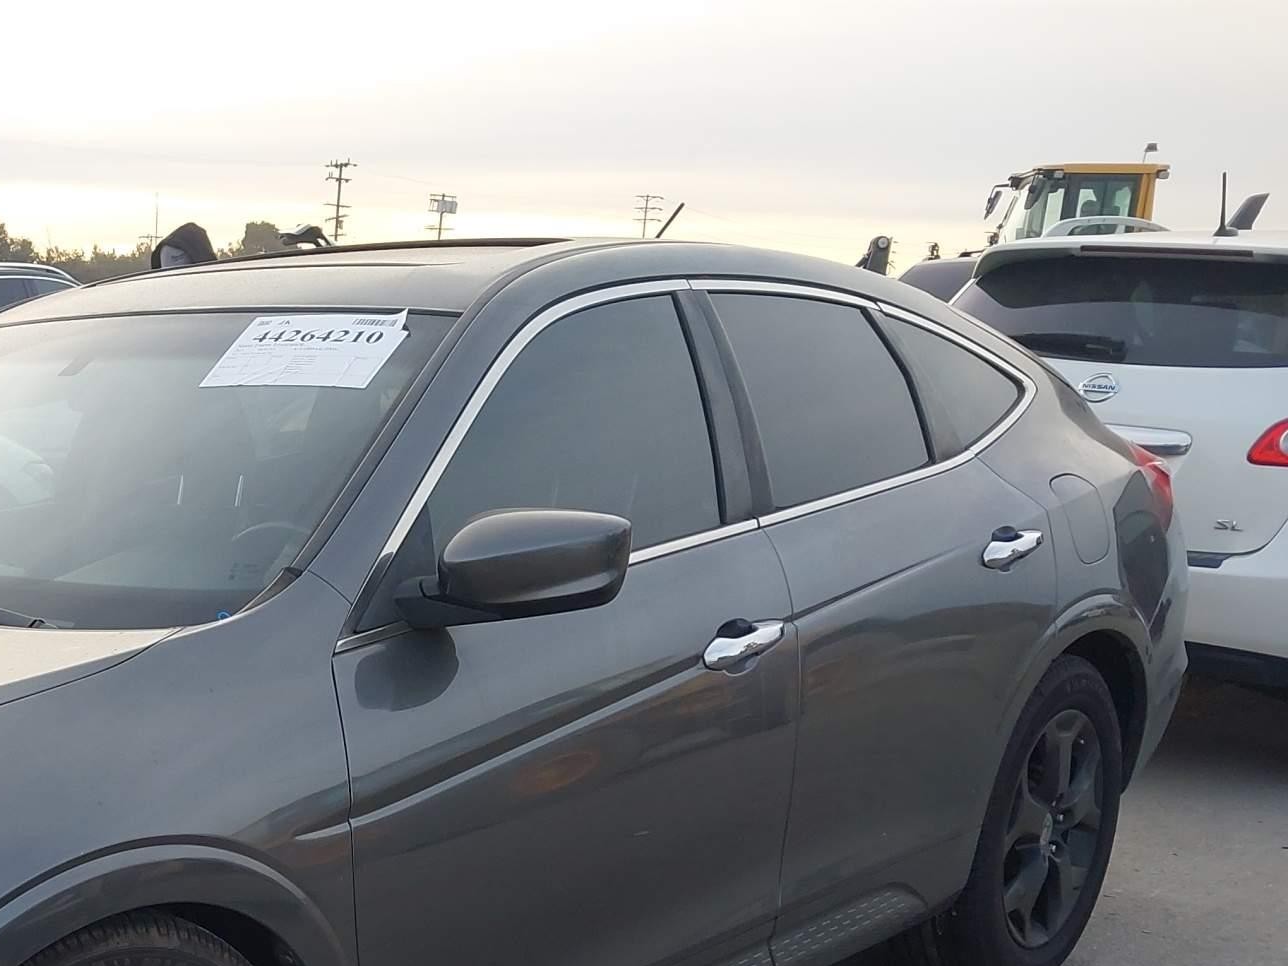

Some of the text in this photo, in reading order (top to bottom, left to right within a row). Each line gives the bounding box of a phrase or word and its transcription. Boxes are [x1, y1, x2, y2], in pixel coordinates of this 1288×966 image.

[252, 329, 384, 344] 44264210
[1082, 383, 1116, 391] NISSAN
[1213, 519, 1244, 532] SL
